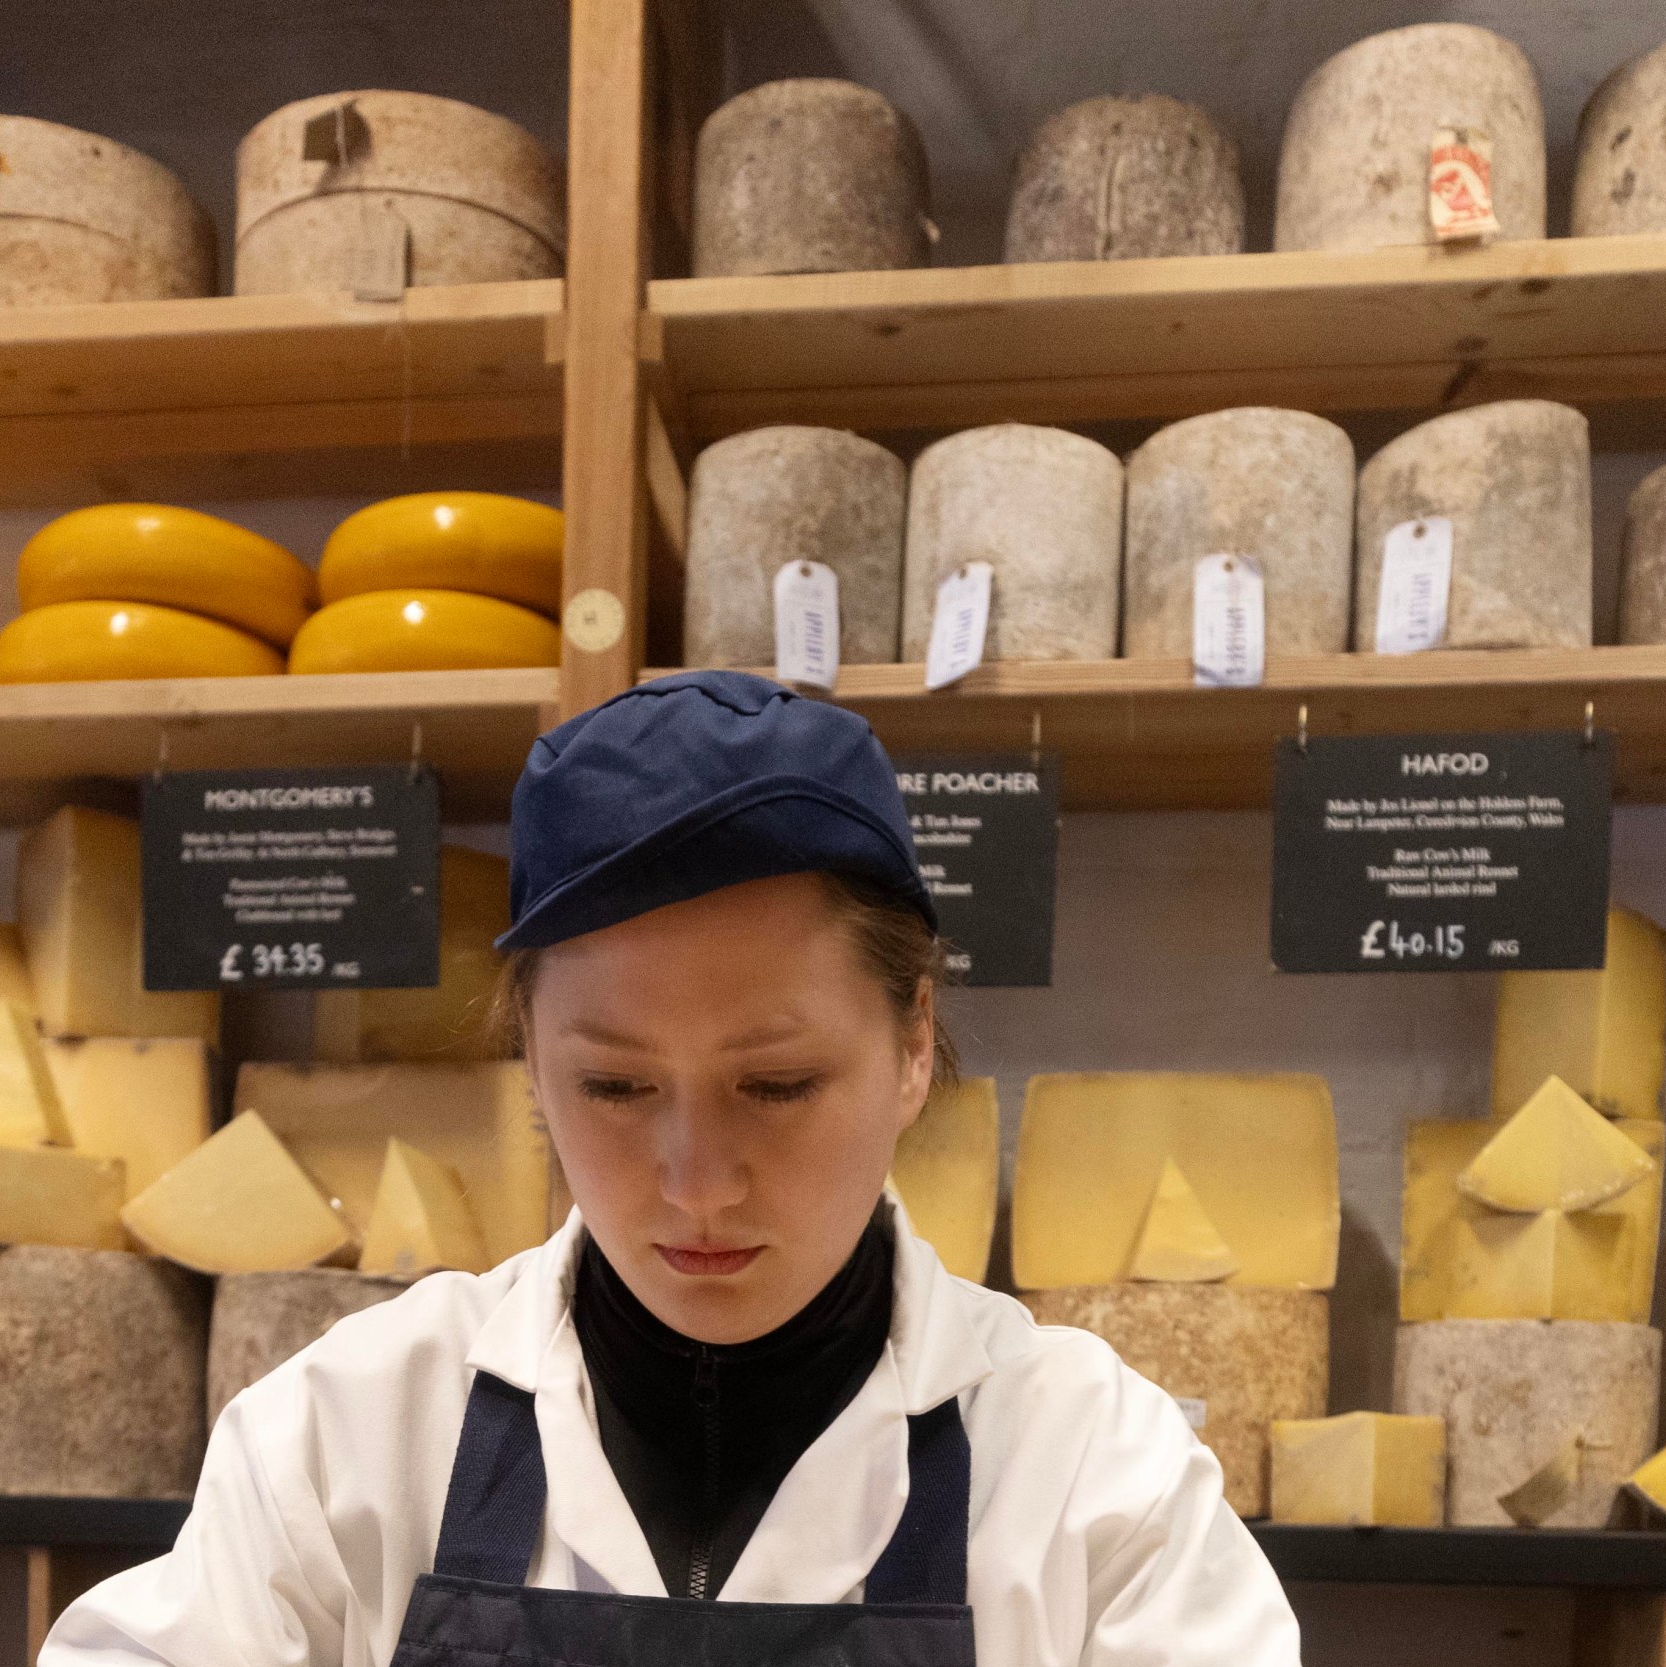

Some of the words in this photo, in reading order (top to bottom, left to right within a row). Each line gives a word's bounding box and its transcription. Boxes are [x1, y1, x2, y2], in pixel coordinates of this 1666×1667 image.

[1400, 752, 1490, 776] HAFOD
[932, 772, 1040, 796] POACHER
[203, 785, 375, 812] MONTGOMERY'S
[1461, 847, 1491, 862] Milk
[1432, 864, 1476, 880] Animal
